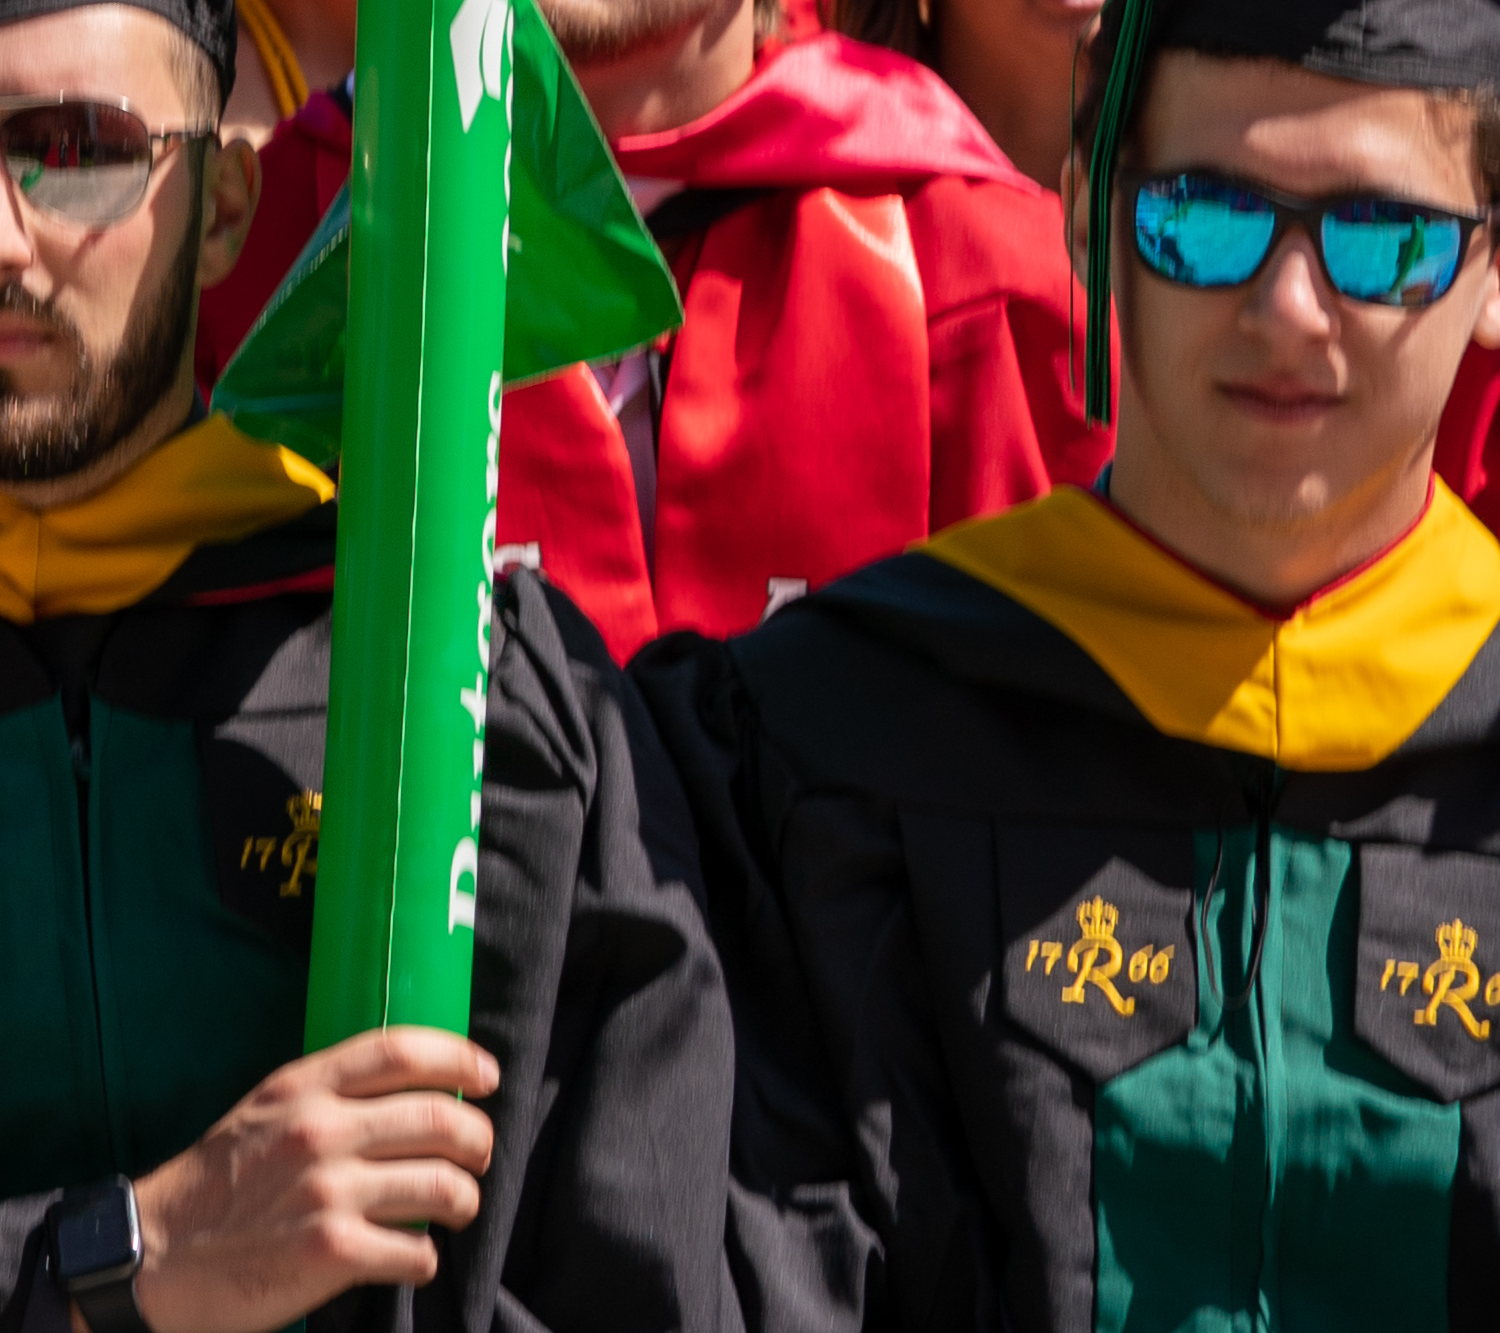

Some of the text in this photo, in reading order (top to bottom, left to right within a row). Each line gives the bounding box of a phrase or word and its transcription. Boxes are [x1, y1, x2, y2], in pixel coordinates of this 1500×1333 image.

[1025, 936, 1175, 1017] 17 R 66
[1380, 958, 1419, 997] 17
[1413, 956, 1491, 1040] R
